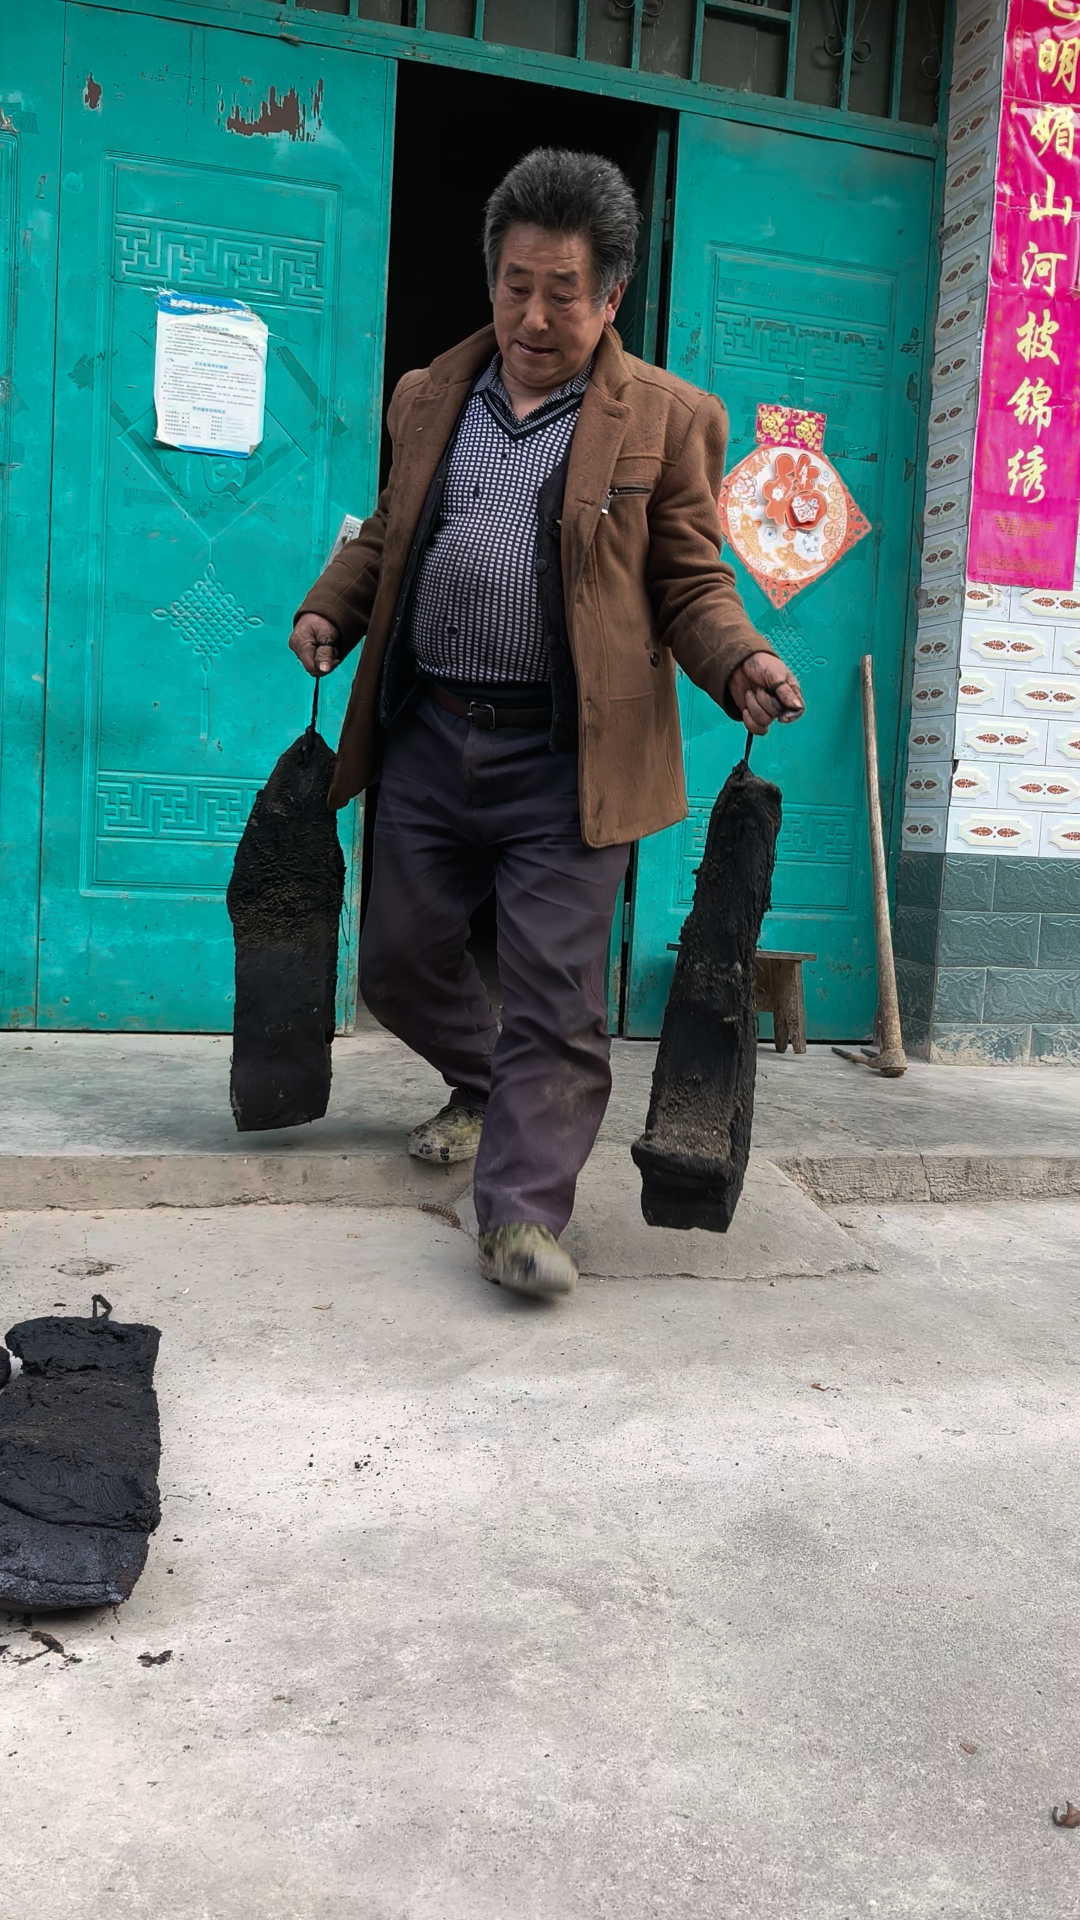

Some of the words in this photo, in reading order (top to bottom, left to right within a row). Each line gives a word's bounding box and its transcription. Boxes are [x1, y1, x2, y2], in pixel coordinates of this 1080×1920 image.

[1007, 0, 1080, 503] 明媚山河披锦绣
